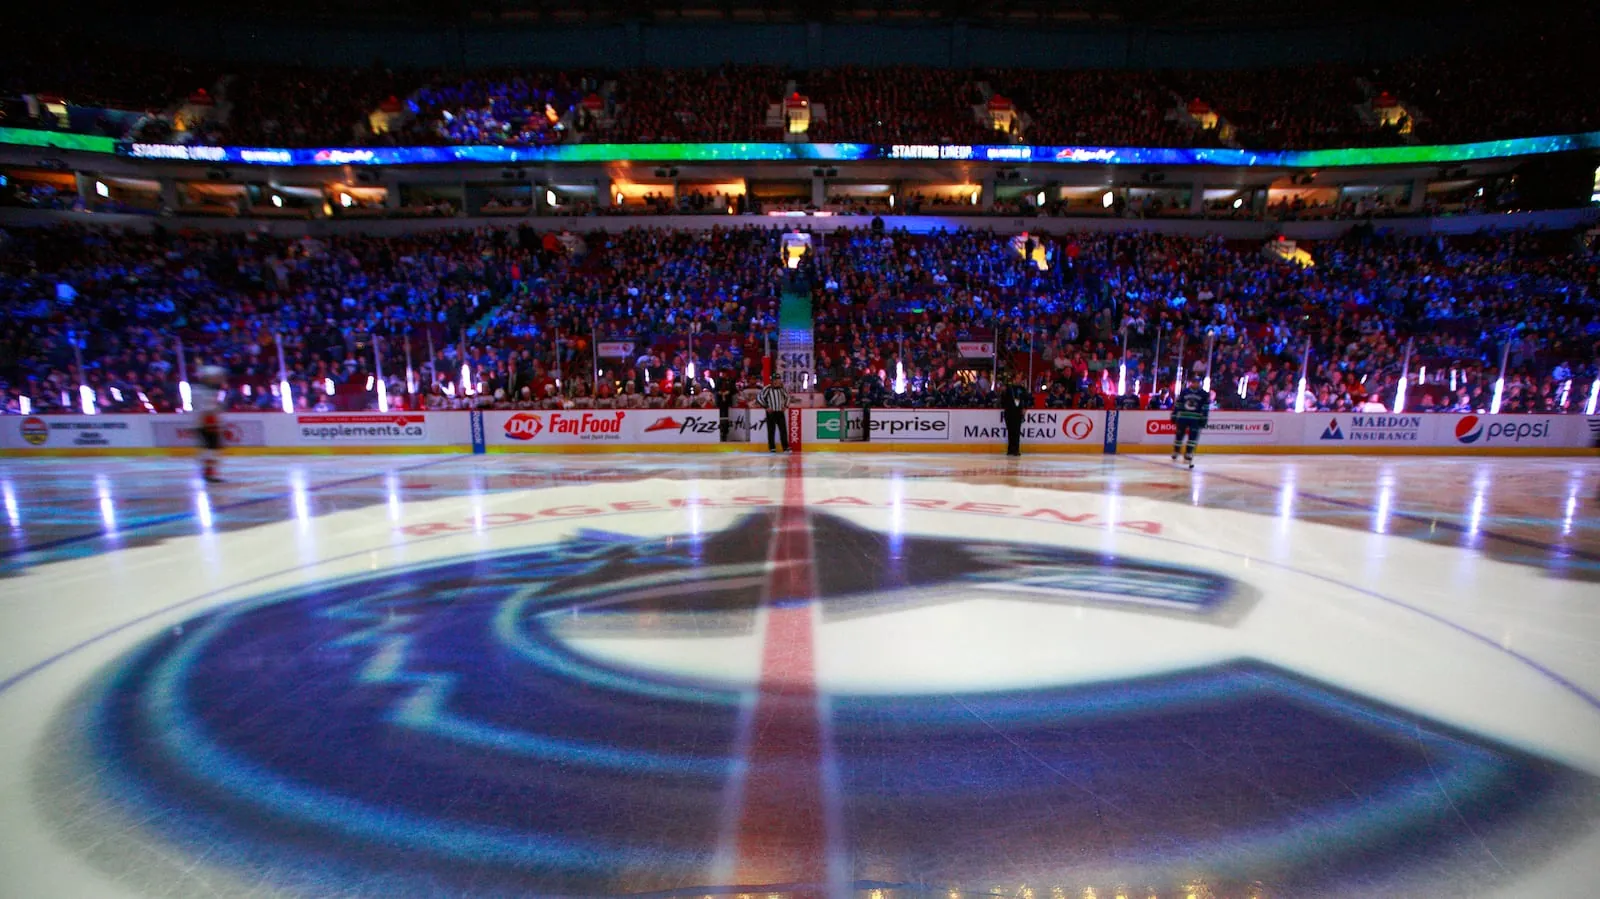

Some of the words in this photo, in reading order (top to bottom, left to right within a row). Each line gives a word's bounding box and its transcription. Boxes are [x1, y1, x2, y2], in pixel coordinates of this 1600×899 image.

[892, 145, 939, 159] STARTING
[941, 145, 972, 159] LINEUP
[790, 409, 800, 443] Reebok
[1351, 416, 1421, 427] MARDON
[302, 426, 423, 438] supplements.ca
[964, 425, 1056, 438] MARTNEAU
[1350, 432, 1417, 441] INSURANCE
[1486, 420, 1550, 442] pepsi
